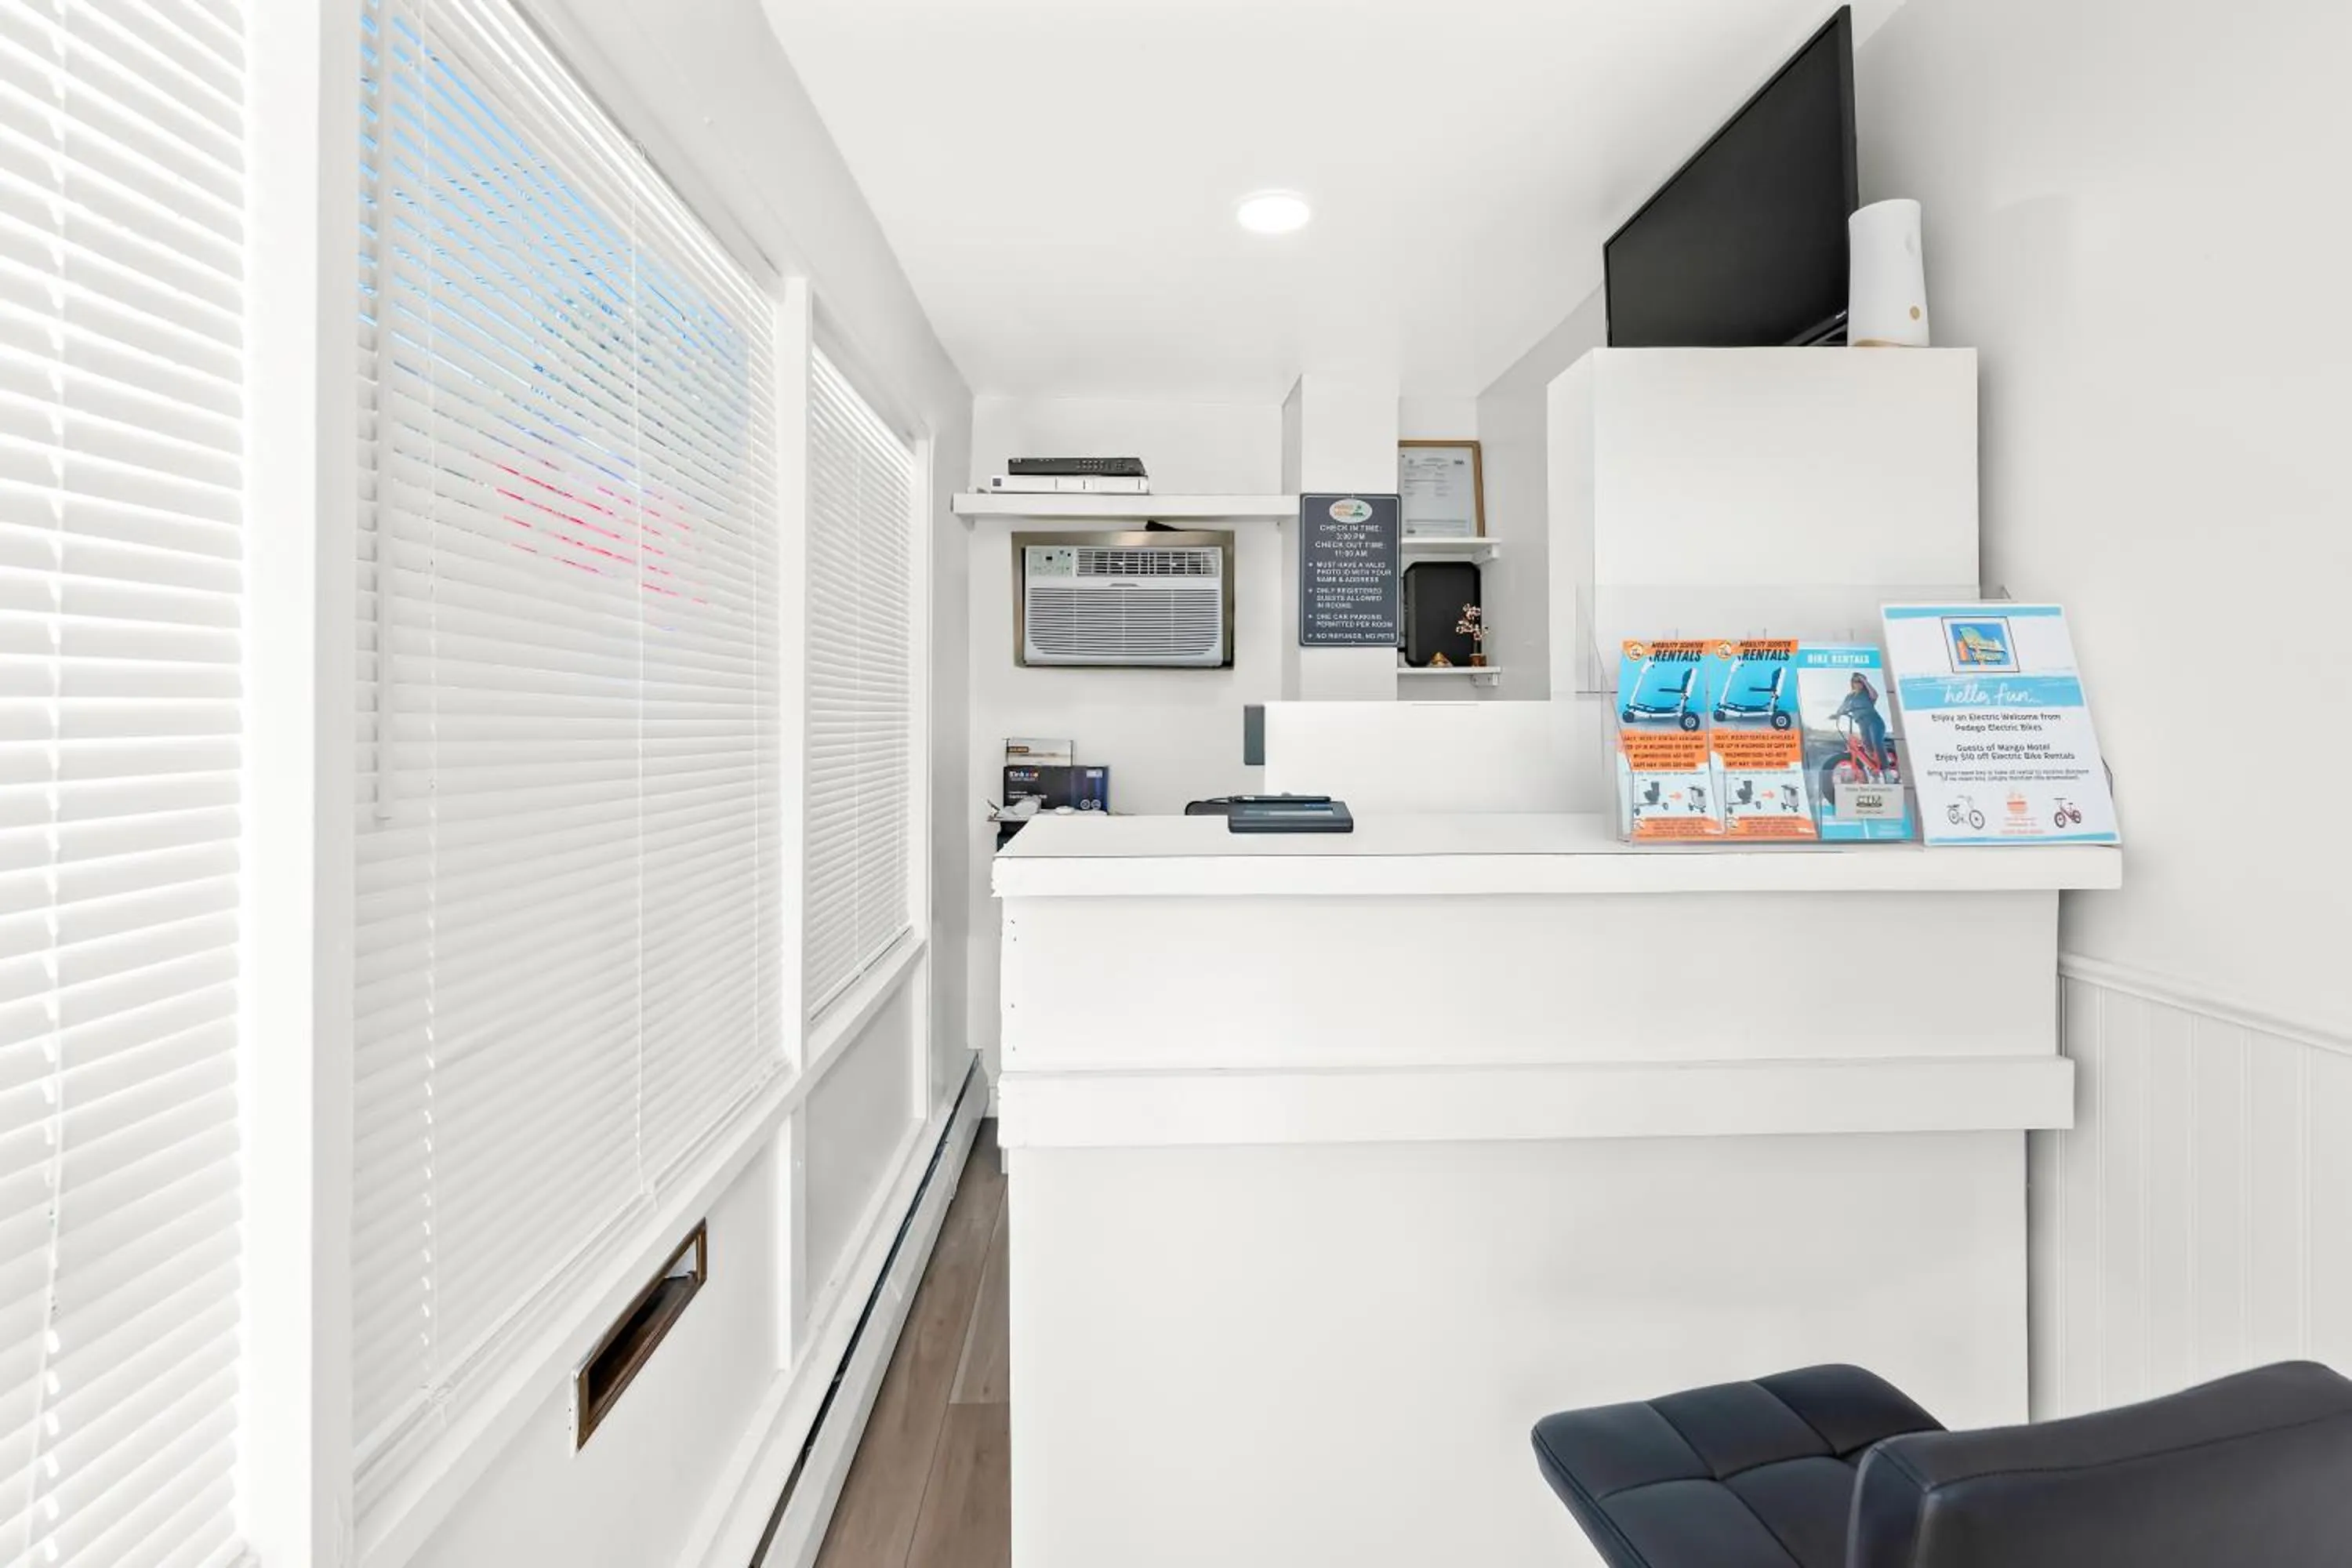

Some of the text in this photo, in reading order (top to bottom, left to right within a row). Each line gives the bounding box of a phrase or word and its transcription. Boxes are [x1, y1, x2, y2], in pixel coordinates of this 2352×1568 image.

[1653, 649, 1702, 662] RENTALS
[1742, 648, 1791, 662] RENTALS
[1807, 654, 1870, 665] BIKE RENTALS
[1931, 714, 1955, 723] Enjoy
[1955, 724, 1986, 733] Pedego
[1997, 744, 2025, 753] Mango
[1935, 753, 1958, 762] Enjoy
